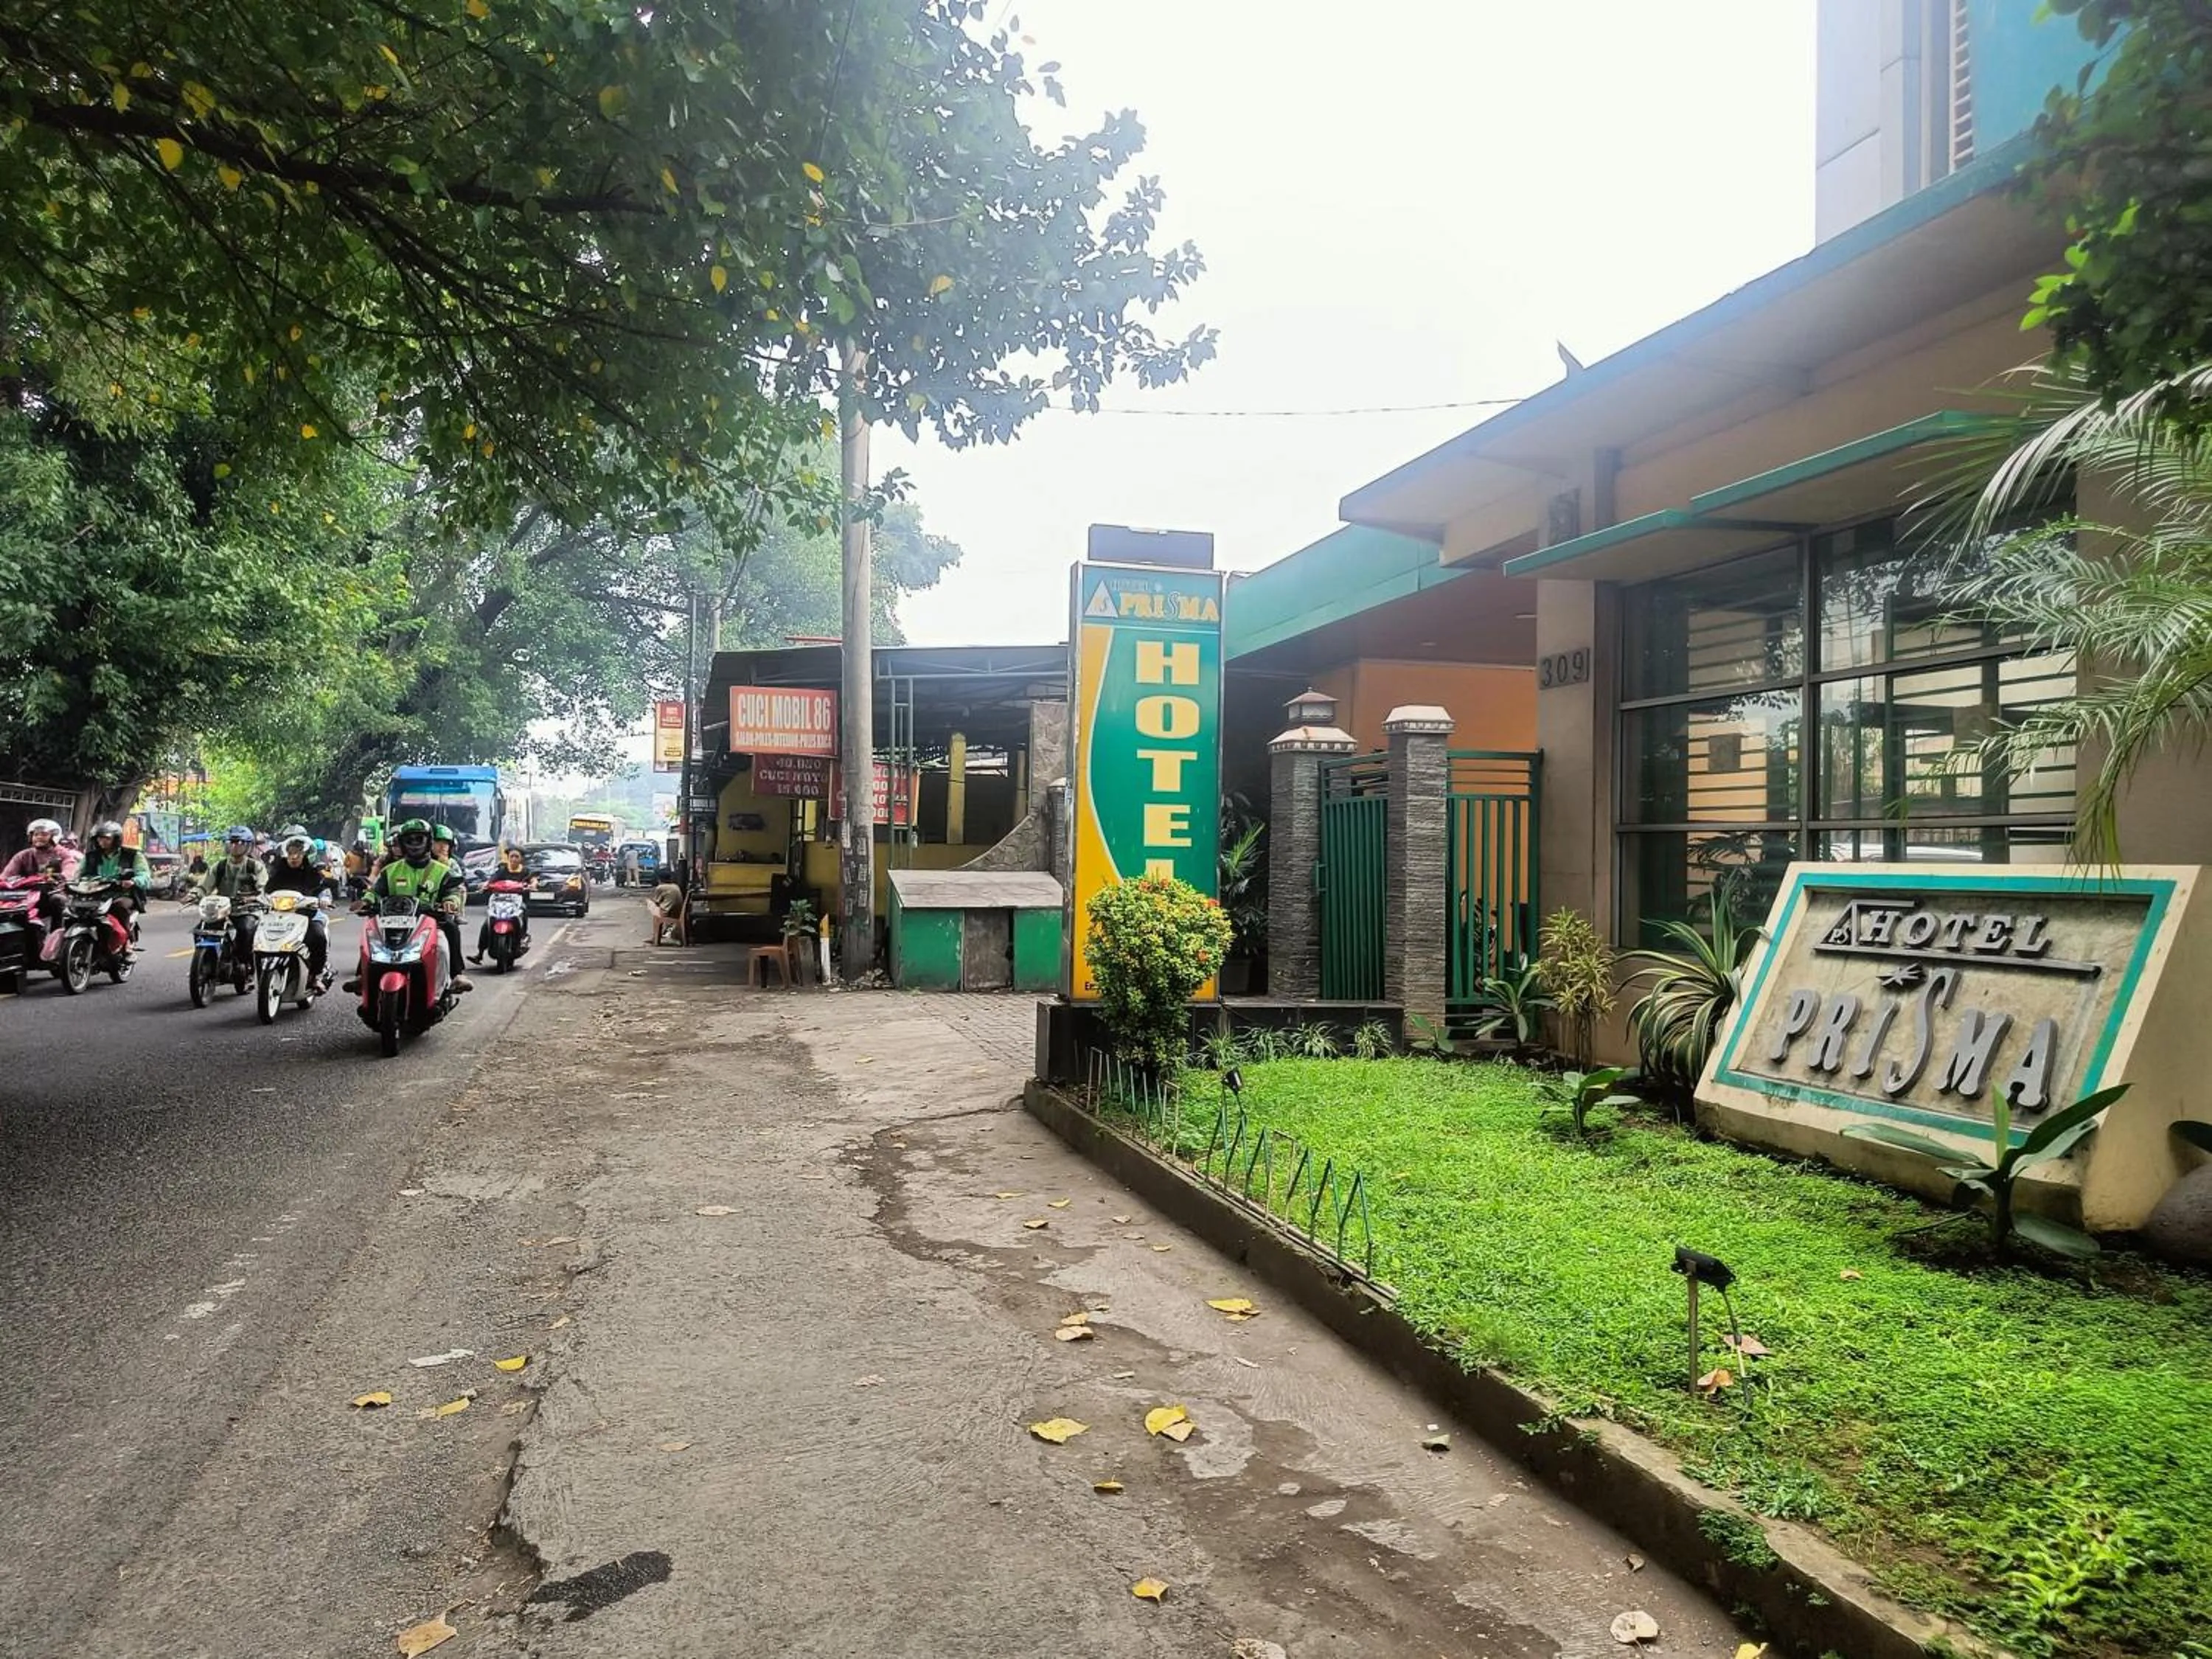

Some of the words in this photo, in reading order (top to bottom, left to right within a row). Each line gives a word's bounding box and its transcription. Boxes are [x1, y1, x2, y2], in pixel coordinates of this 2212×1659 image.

[1119, 591, 1220, 622] PRISMA
[1542, 651, 1584, 686] 309
[738, 693, 769, 728] CUCI
[772, 695, 812, 730] MOBIL
[813, 696, 831, 731] 86
[1859, 910, 2053, 954] HOTEL
[1770, 967, 2059, 1110] PRISMA
